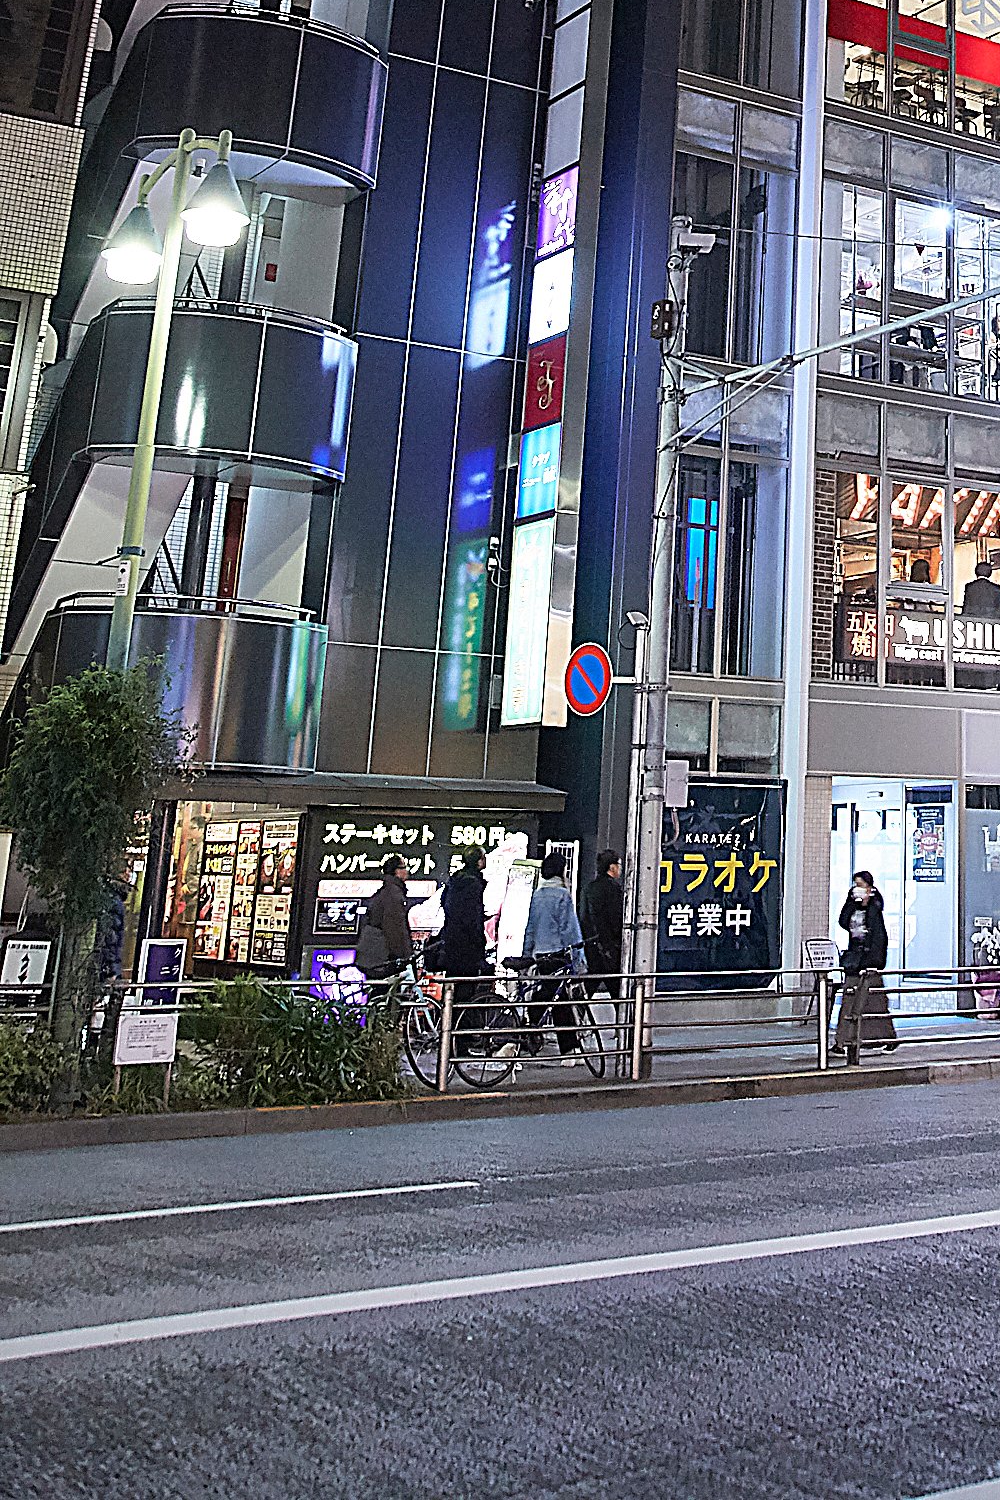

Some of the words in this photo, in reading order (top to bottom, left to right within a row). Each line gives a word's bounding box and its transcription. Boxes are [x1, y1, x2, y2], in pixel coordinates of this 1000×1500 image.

[323, 823, 434, 846] ステーキセット
[450, 825, 506, 847] 580円
[320, 853, 436, 874] ハンバーット
[667, 903, 752, 937] 営業中
